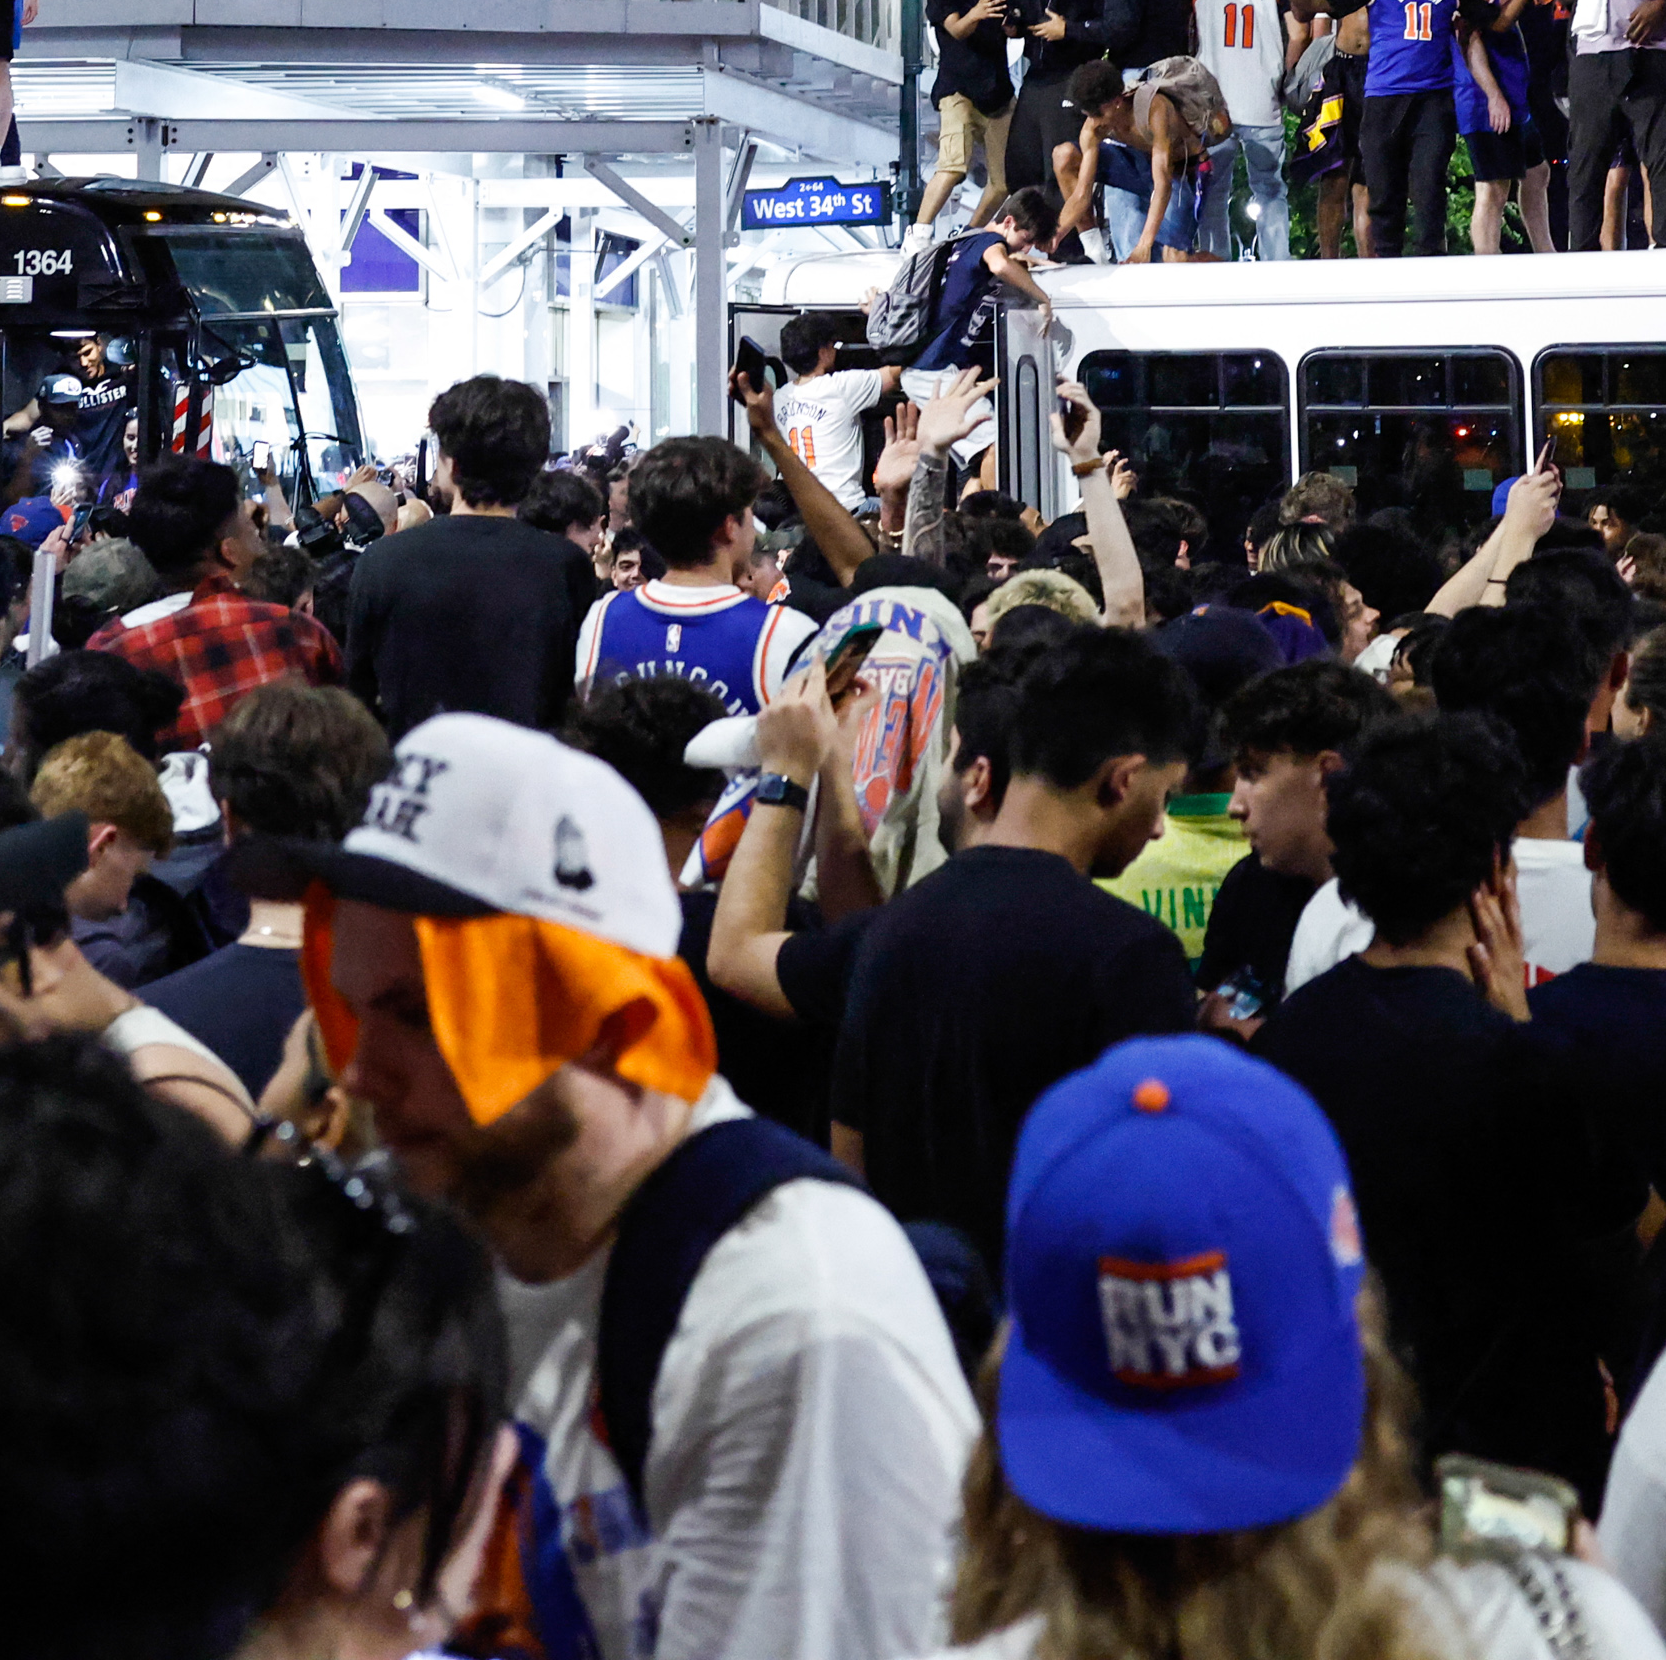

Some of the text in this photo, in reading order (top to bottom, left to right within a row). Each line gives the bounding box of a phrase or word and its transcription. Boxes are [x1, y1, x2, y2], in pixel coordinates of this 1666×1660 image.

[1223, 2, 1255, 49] 11
[1403, 0, 1433, 41] 11
[752, 192, 874, 220] West 34th St
[13, 249, 74, 276] 1364
[776, 401, 828, 427] BRUNSON
[1141, 887, 1220, 929] VIN
[1099, 1270, 1233, 1328] RUN
[1106, 1321, 1241, 1377] NYC
